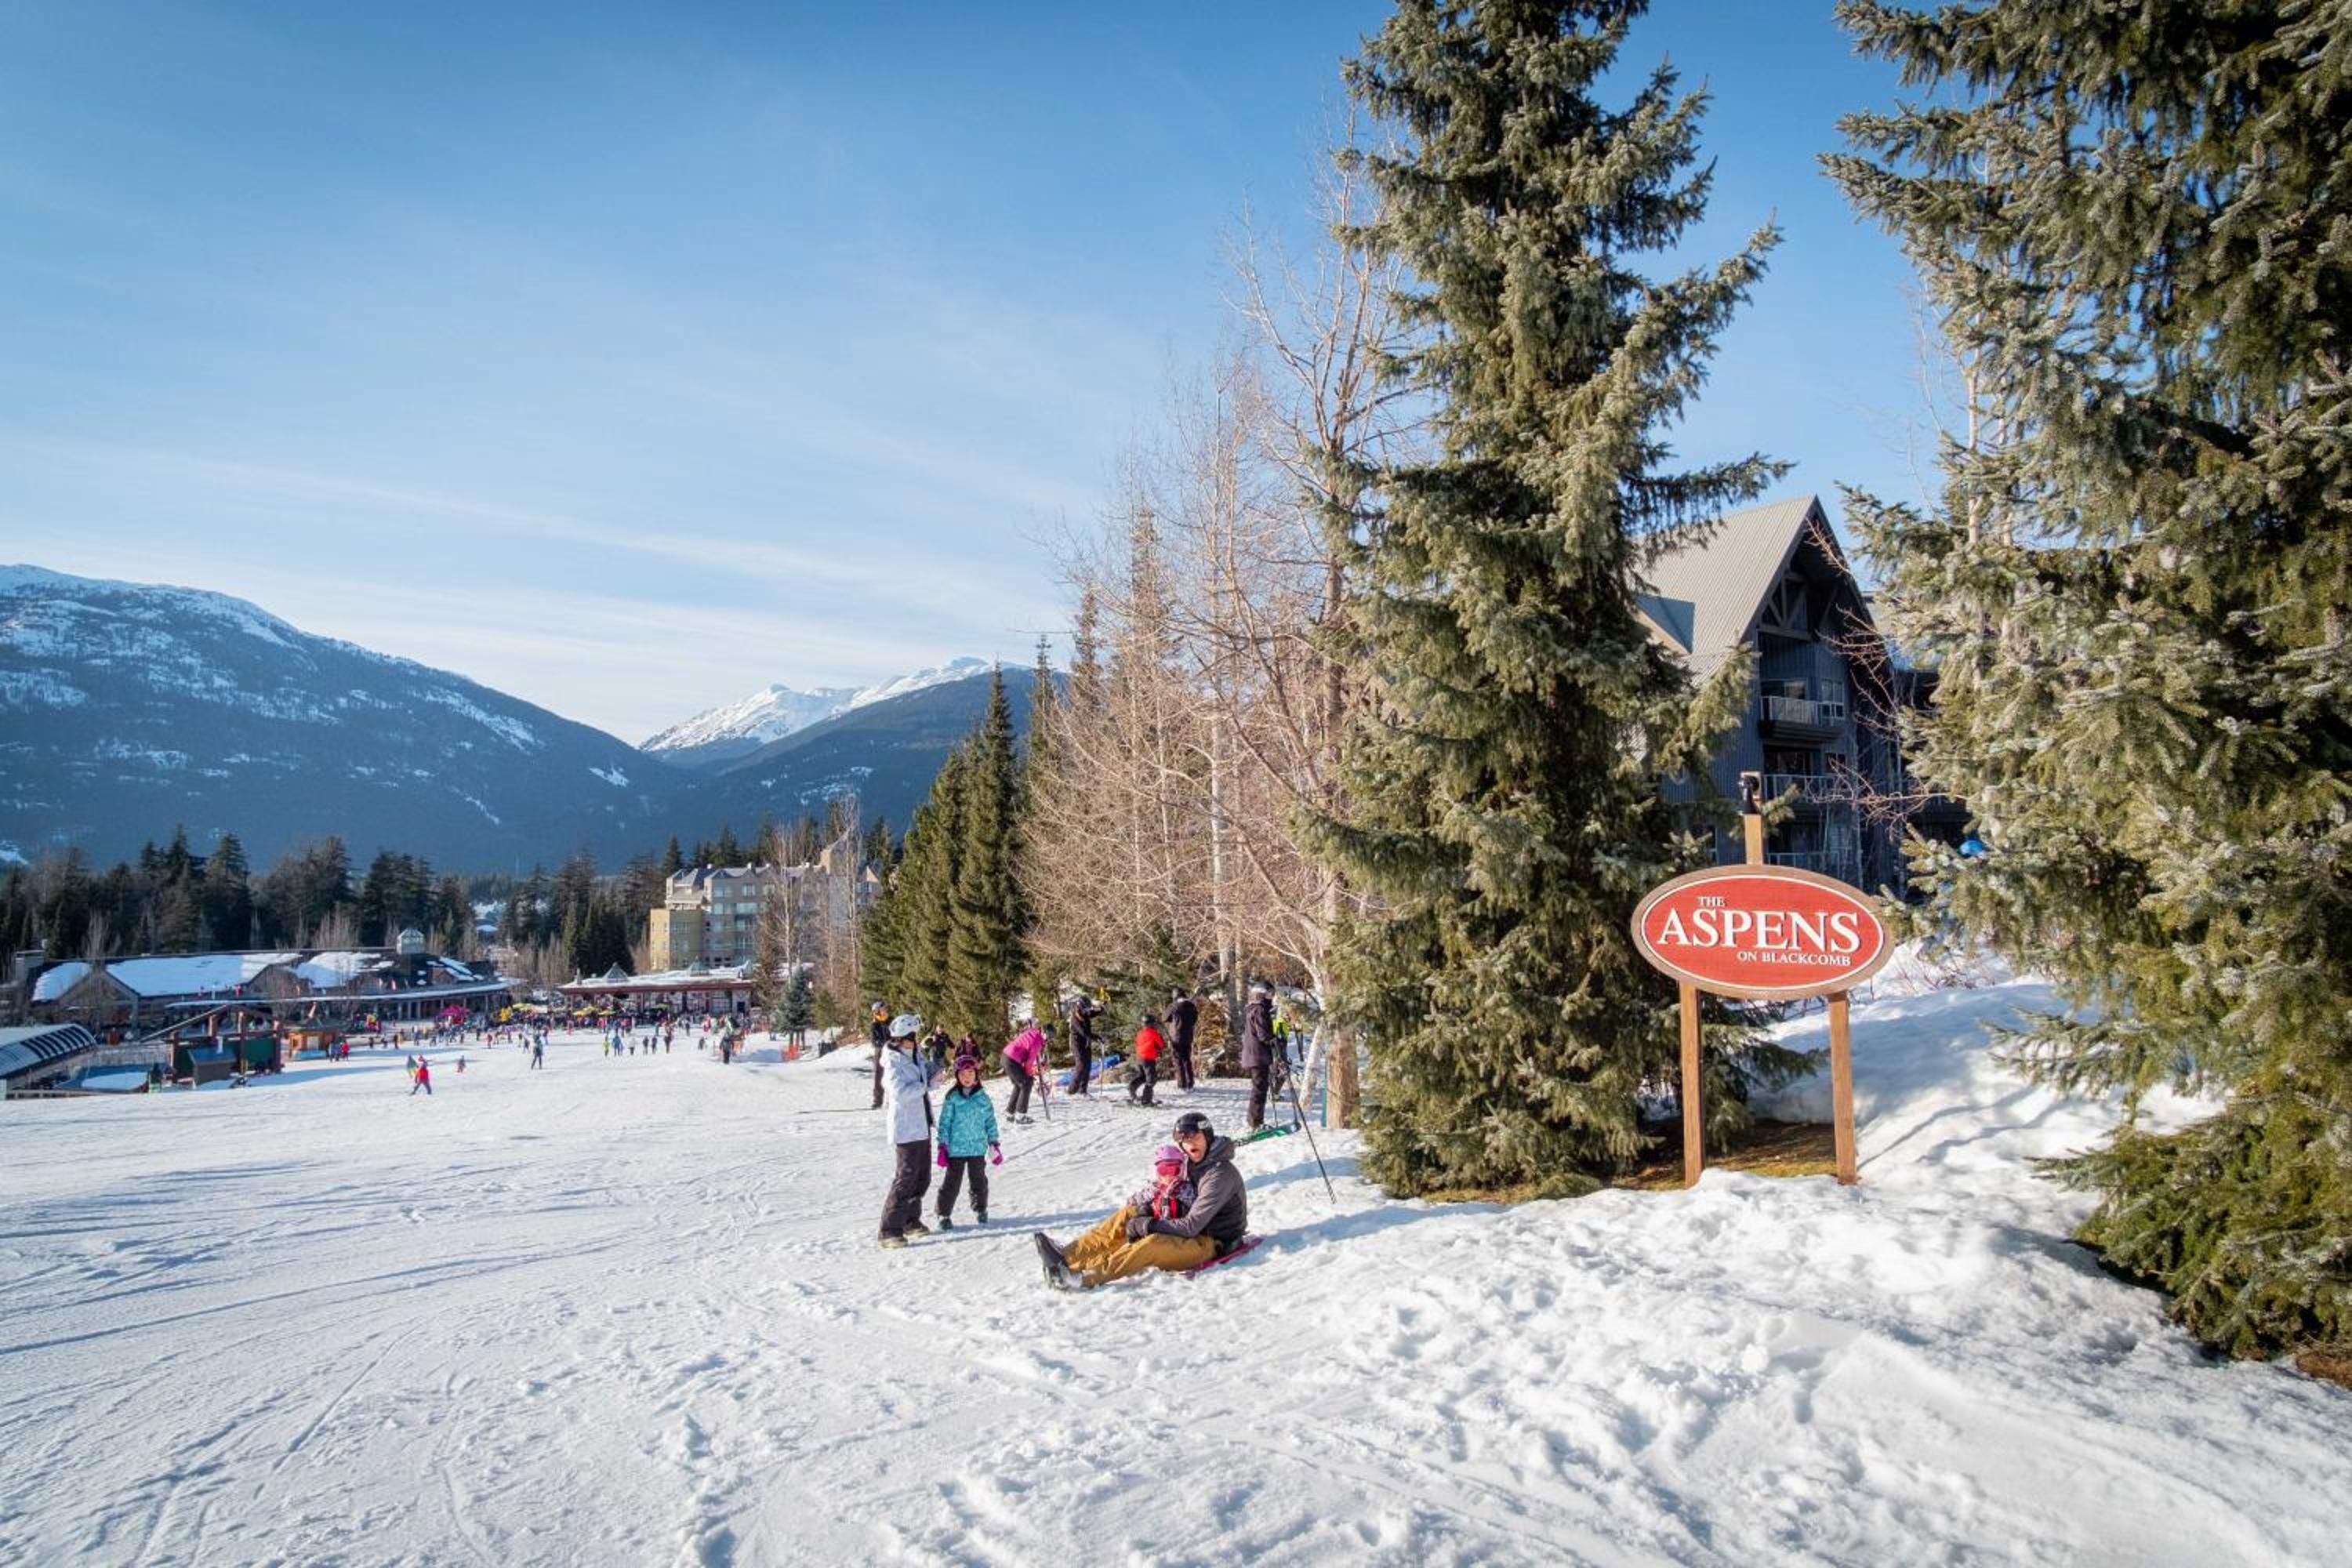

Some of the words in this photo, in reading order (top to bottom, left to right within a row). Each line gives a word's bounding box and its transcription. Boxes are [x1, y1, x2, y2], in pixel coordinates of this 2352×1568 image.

[1698, 896, 1725, 907] THE
[1657, 908, 1860, 953] ASPENS
[1737, 951, 1757, 962] ON
[1762, 953, 1851, 966] BLACKCOMB
